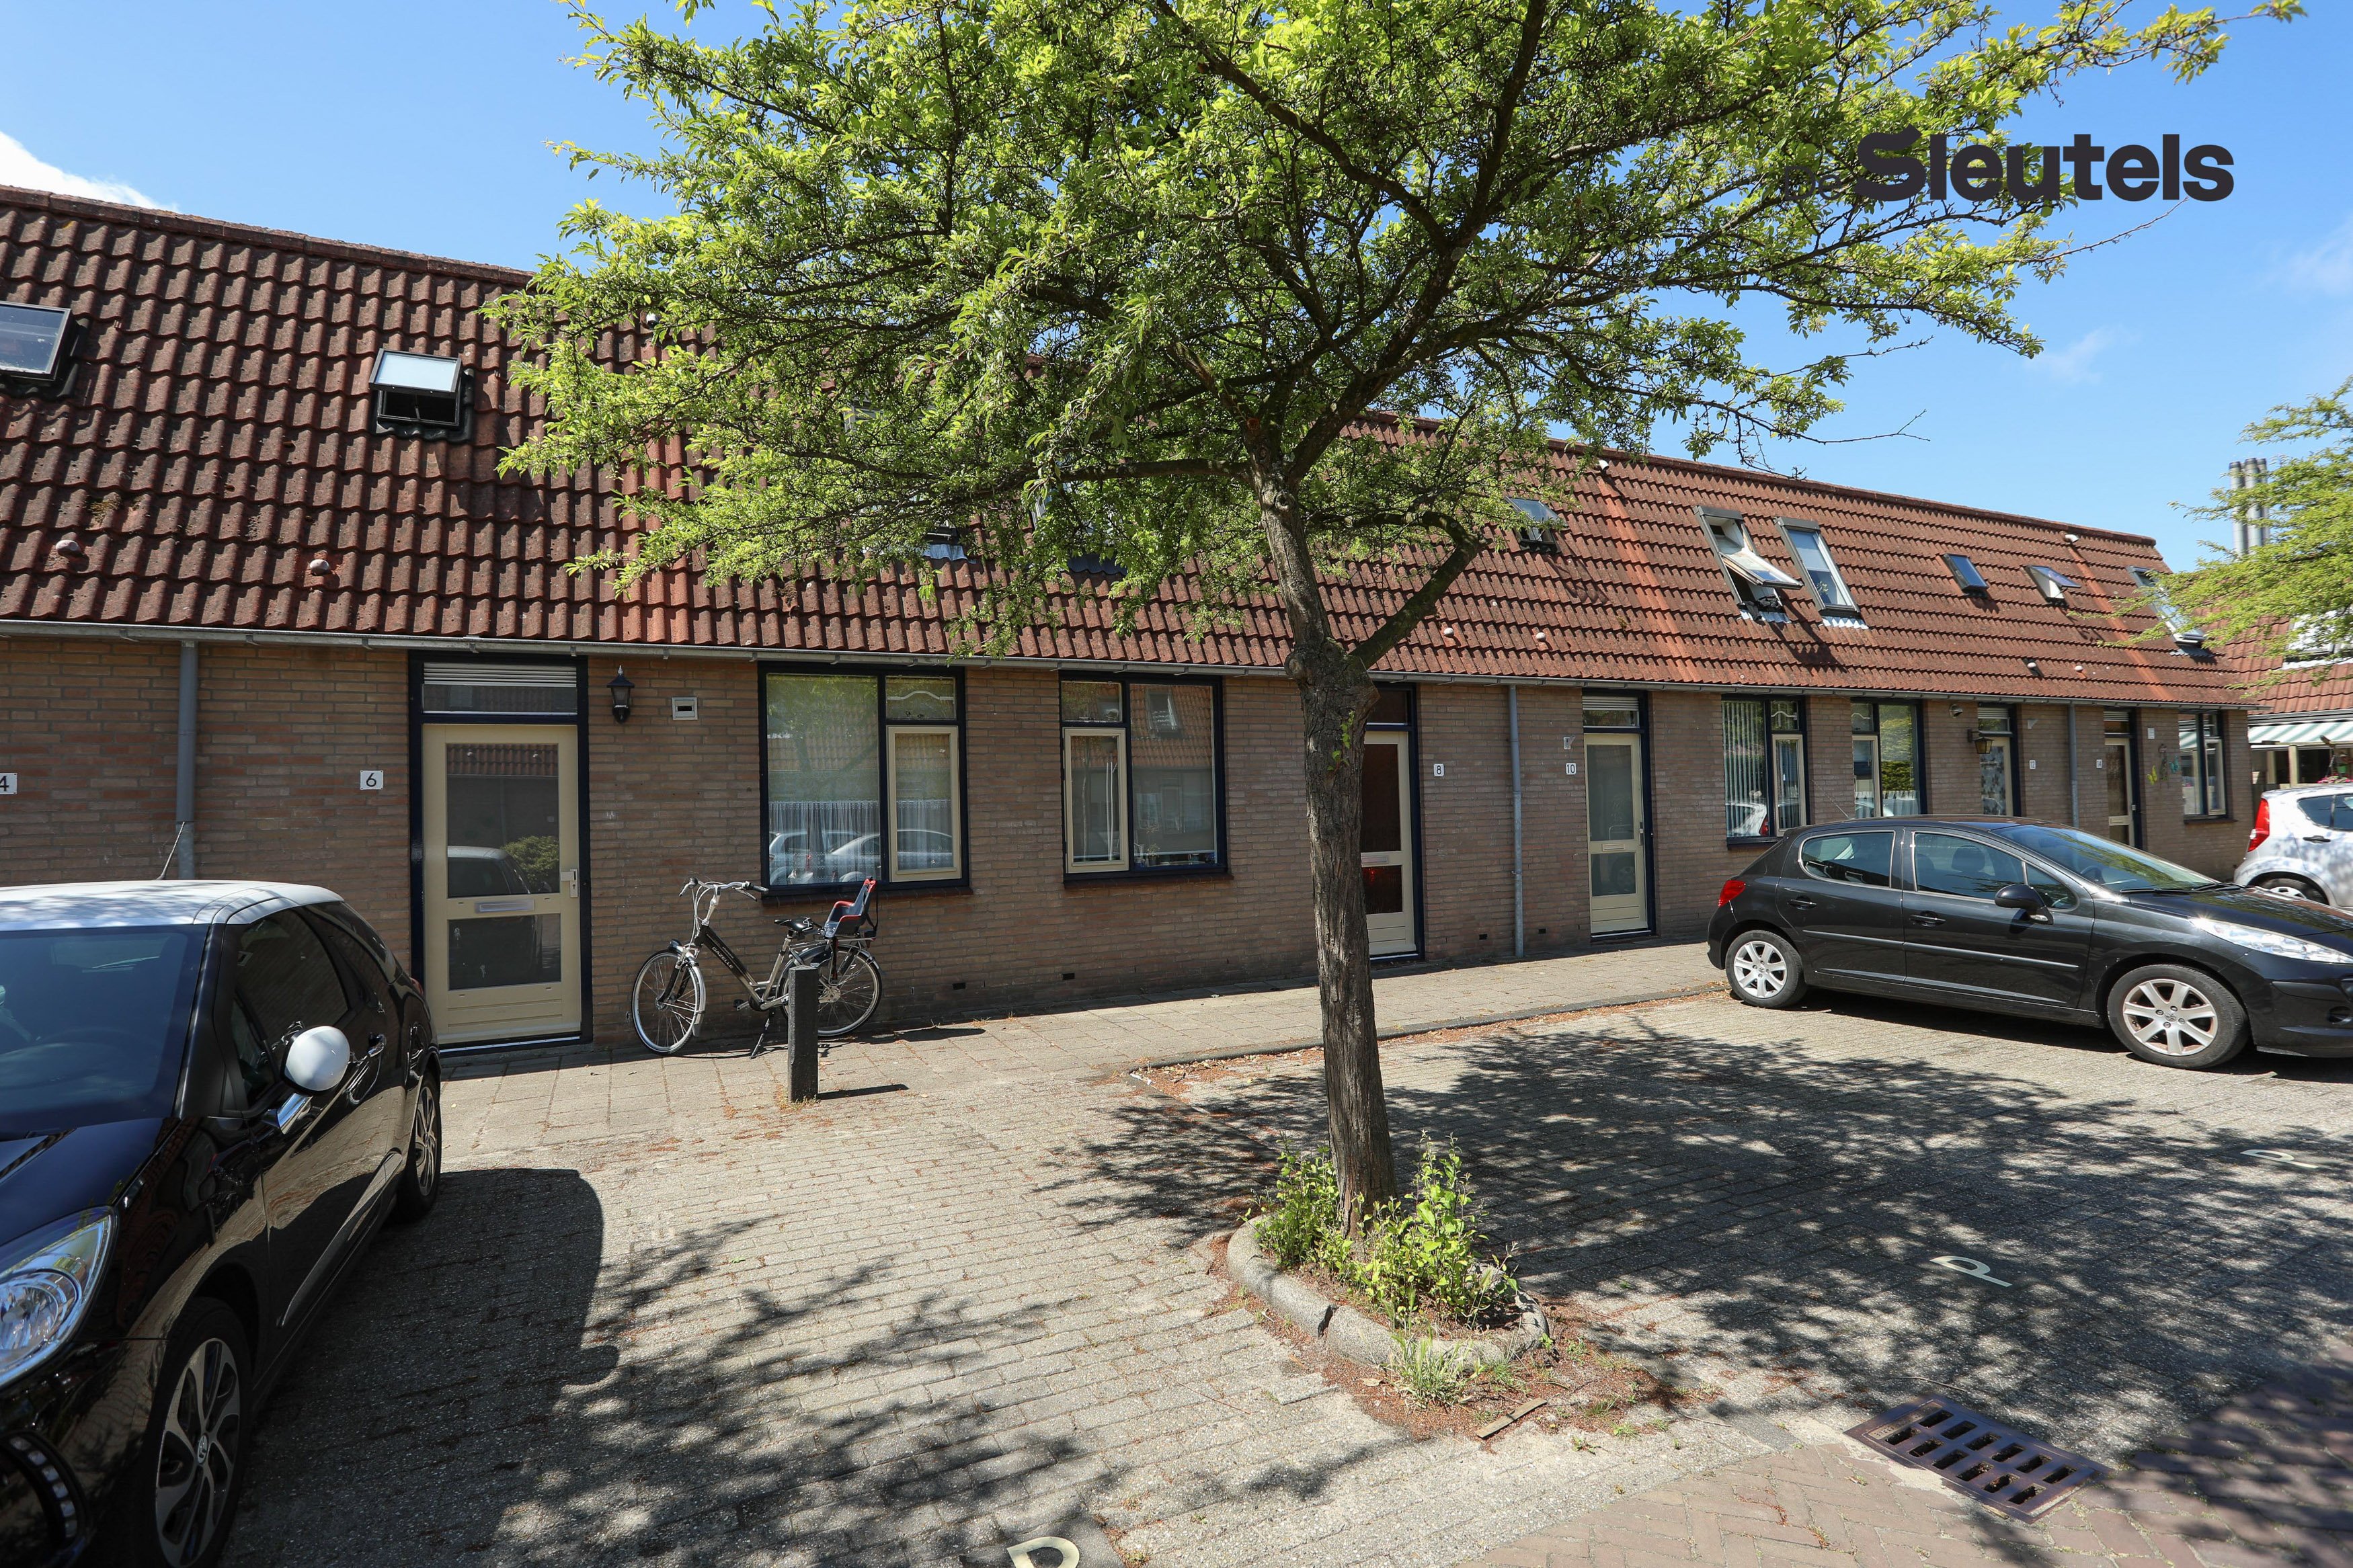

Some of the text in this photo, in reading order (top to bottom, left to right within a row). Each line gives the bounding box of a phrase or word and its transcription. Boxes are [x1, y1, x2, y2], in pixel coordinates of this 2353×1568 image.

[1436, 765, 1442, 775] 8
[1566, 764, 1575, 774] 10
[0, 775, 9, 792] 4
[366, 772, 376, 787] 6
[712, 946, 733, 968] GAZELLE
[2239, 1149, 2319, 1169] P
[1929, 1255, 2013, 1288] P
